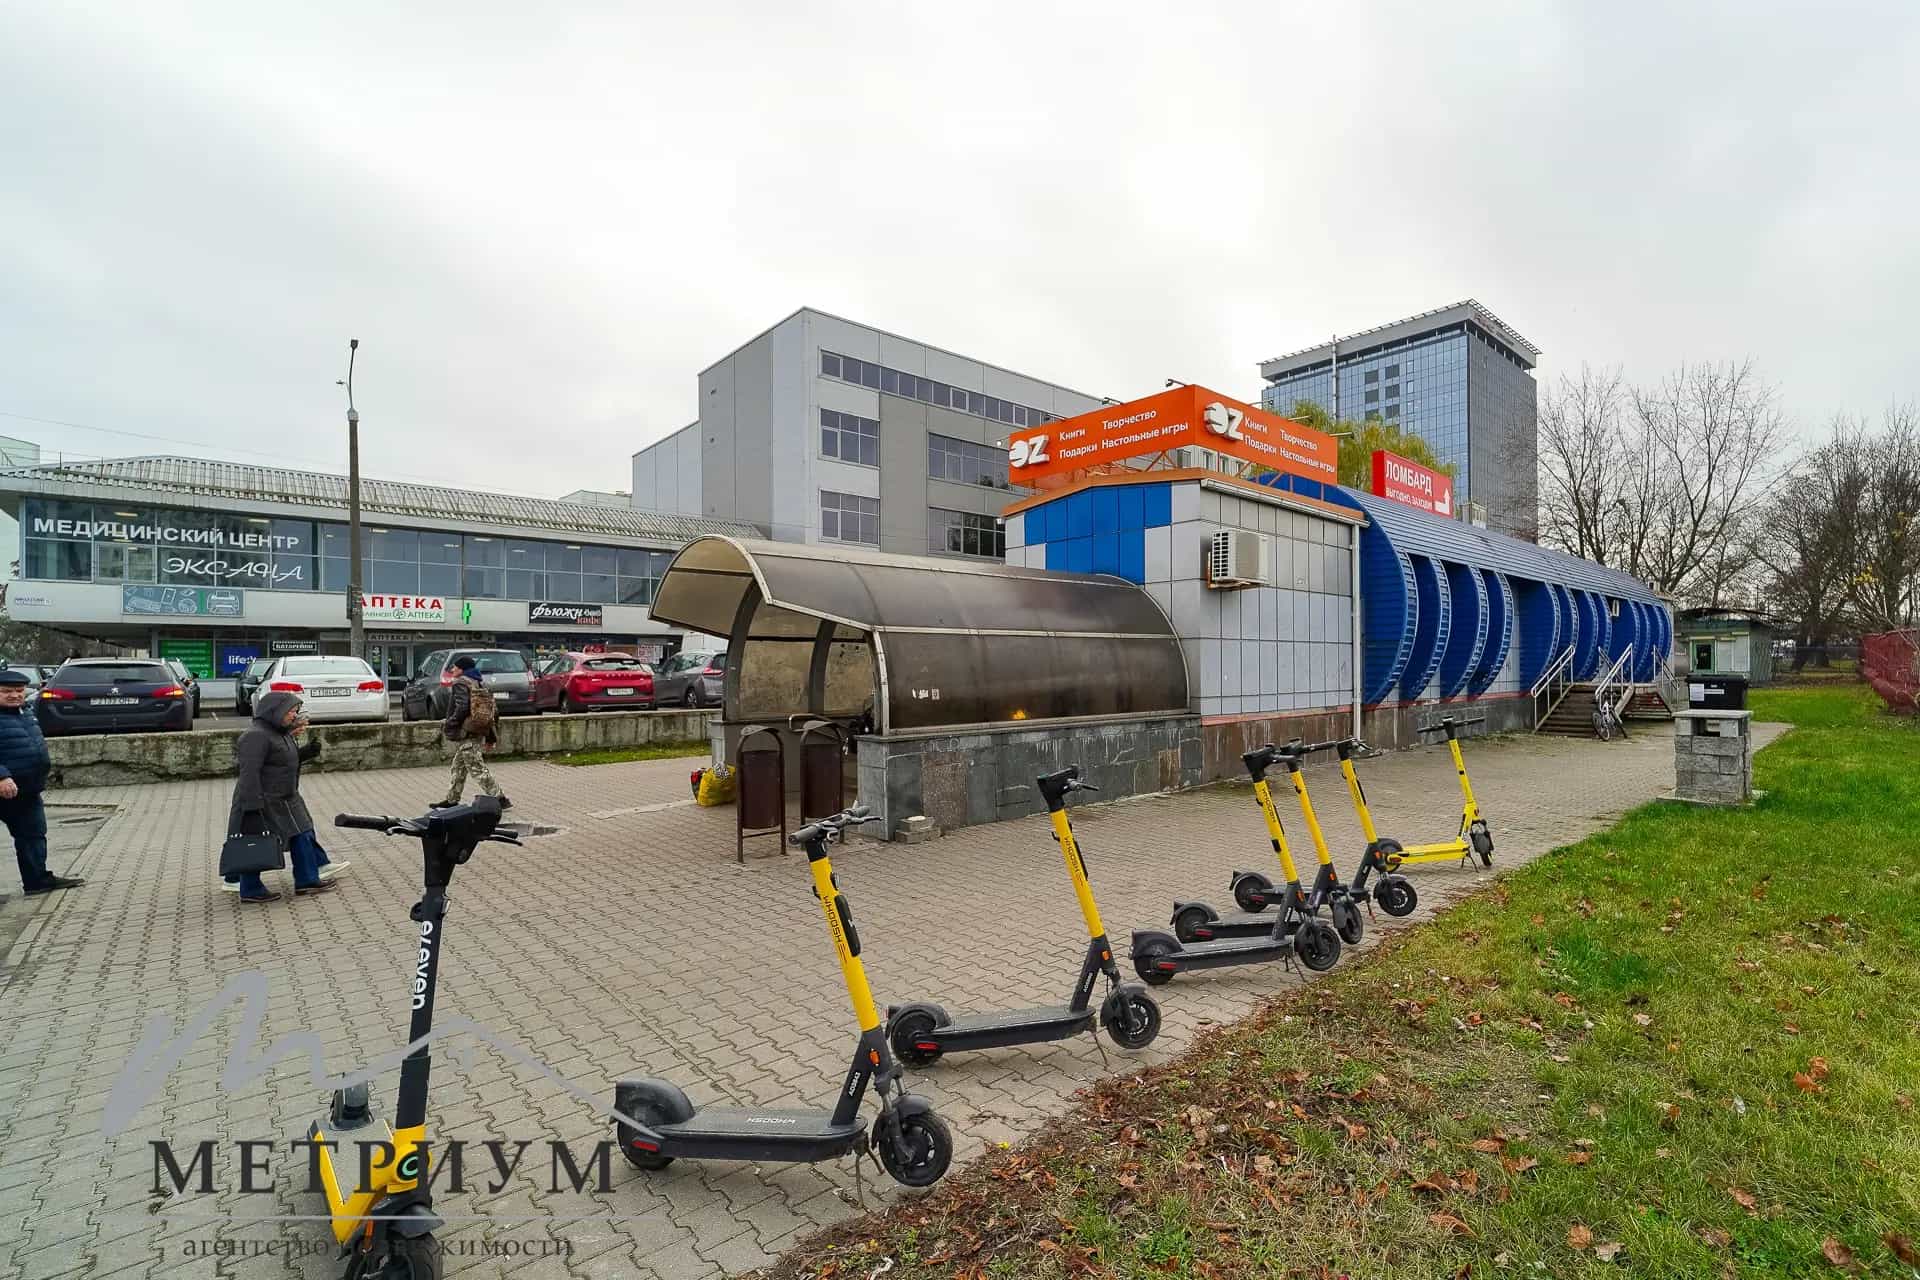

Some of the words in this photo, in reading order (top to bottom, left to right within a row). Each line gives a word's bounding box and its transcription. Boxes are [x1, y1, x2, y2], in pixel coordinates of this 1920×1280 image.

[1059, 428, 1086, 442] Книги
[1102, 410, 1157, 430] Творчество
[1059, 443, 1098, 459] Подарки
[1101, 430, 1159, 449] Настольные
[1161, 422, 1188, 436] игры
[1245, 416, 1268, 433] Книги
[1279, 429, 1318, 450] Творчество
[1245, 435, 1276, 454] Подарки
[1280, 447, 1319, 467] Настольные
[1319, 462, 1335, 473] игры
[1386, 461, 1433, 496] ЛОМБАРД
[34, 517, 224, 545] МЕДИЦИНСКИЙ
[229, 532, 300, 549] ЦЕНТР
[407, 611, 442, 619] АПТЕКА
[823, 896, 842, 942] WHOOSH
[413, 921, 434, 1010] eleven
